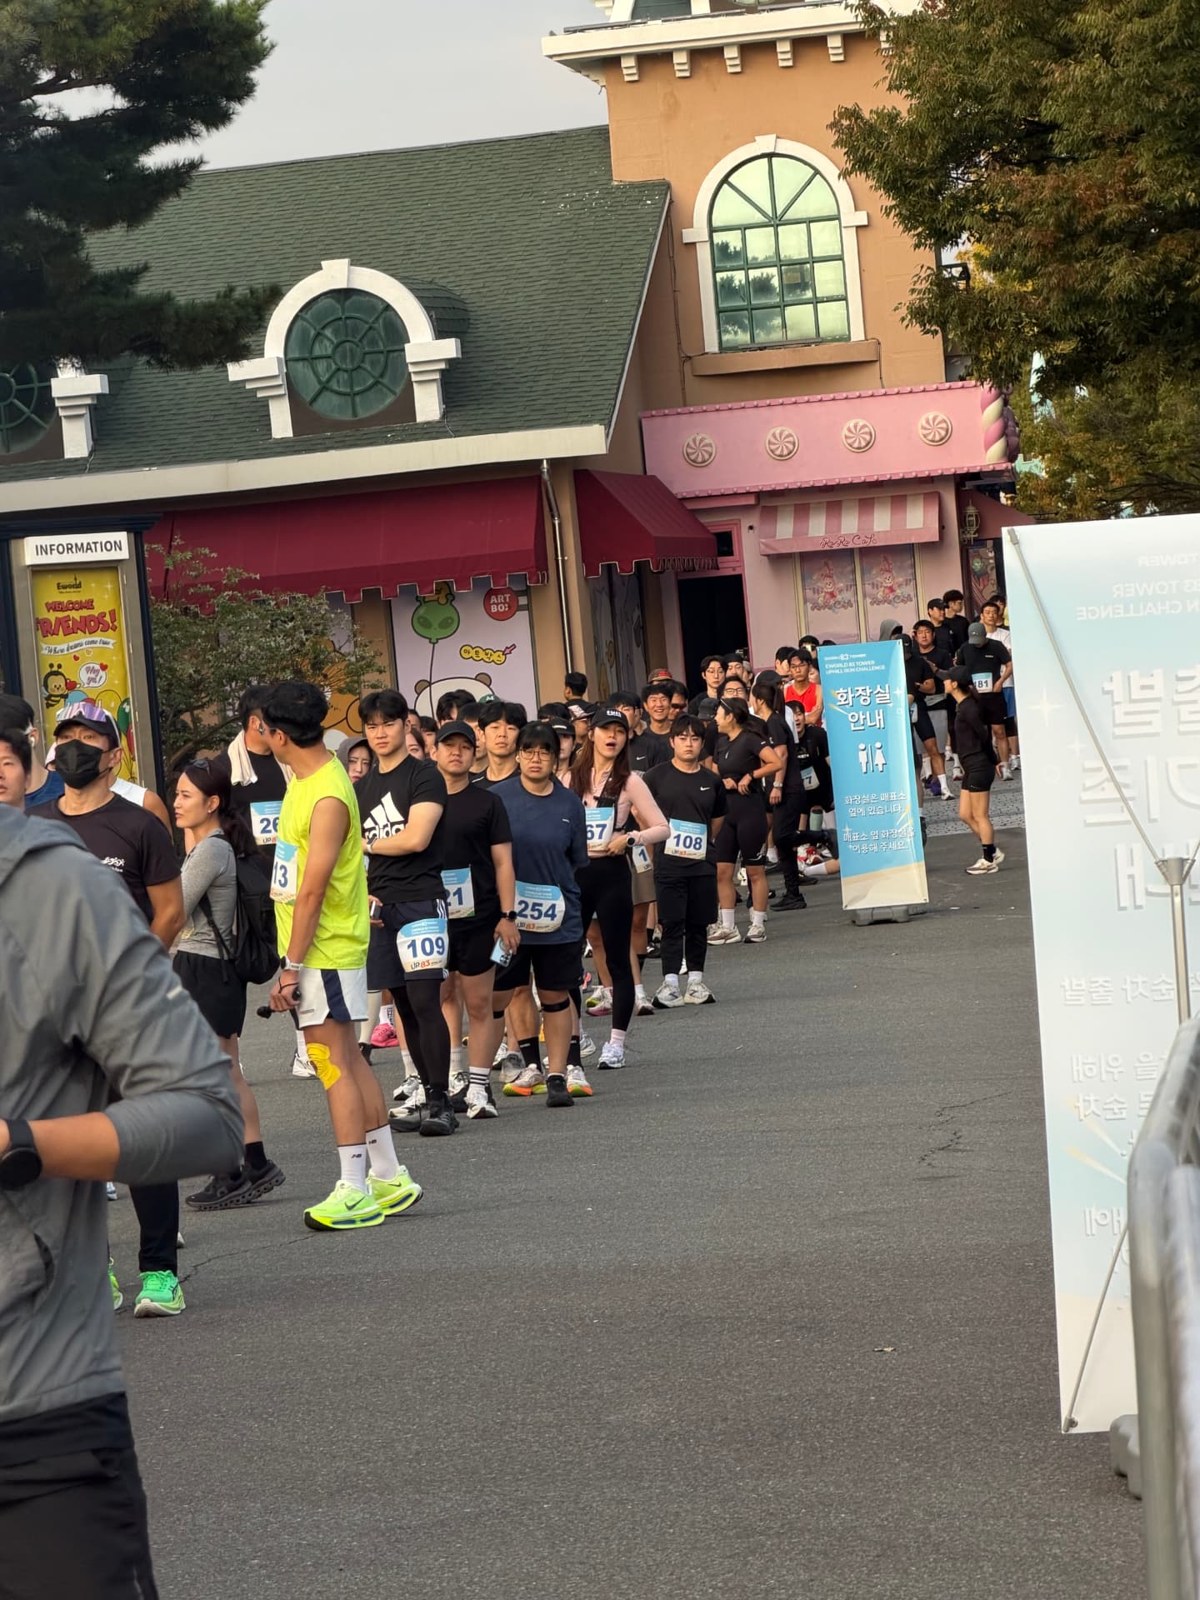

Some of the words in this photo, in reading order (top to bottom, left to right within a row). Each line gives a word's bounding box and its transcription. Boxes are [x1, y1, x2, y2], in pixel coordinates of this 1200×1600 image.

[35, 540, 123, 556] INFORMATION
[45, 599, 95, 613] WELCOME
[490, 594, 511, 604] ART
[835, 684, 893, 707] 화장실
[848, 709, 885, 731] 안내
[673, 833, 703, 851] 108
[516, 899, 557, 921] 254
[407, 936, 446, 959] 109
